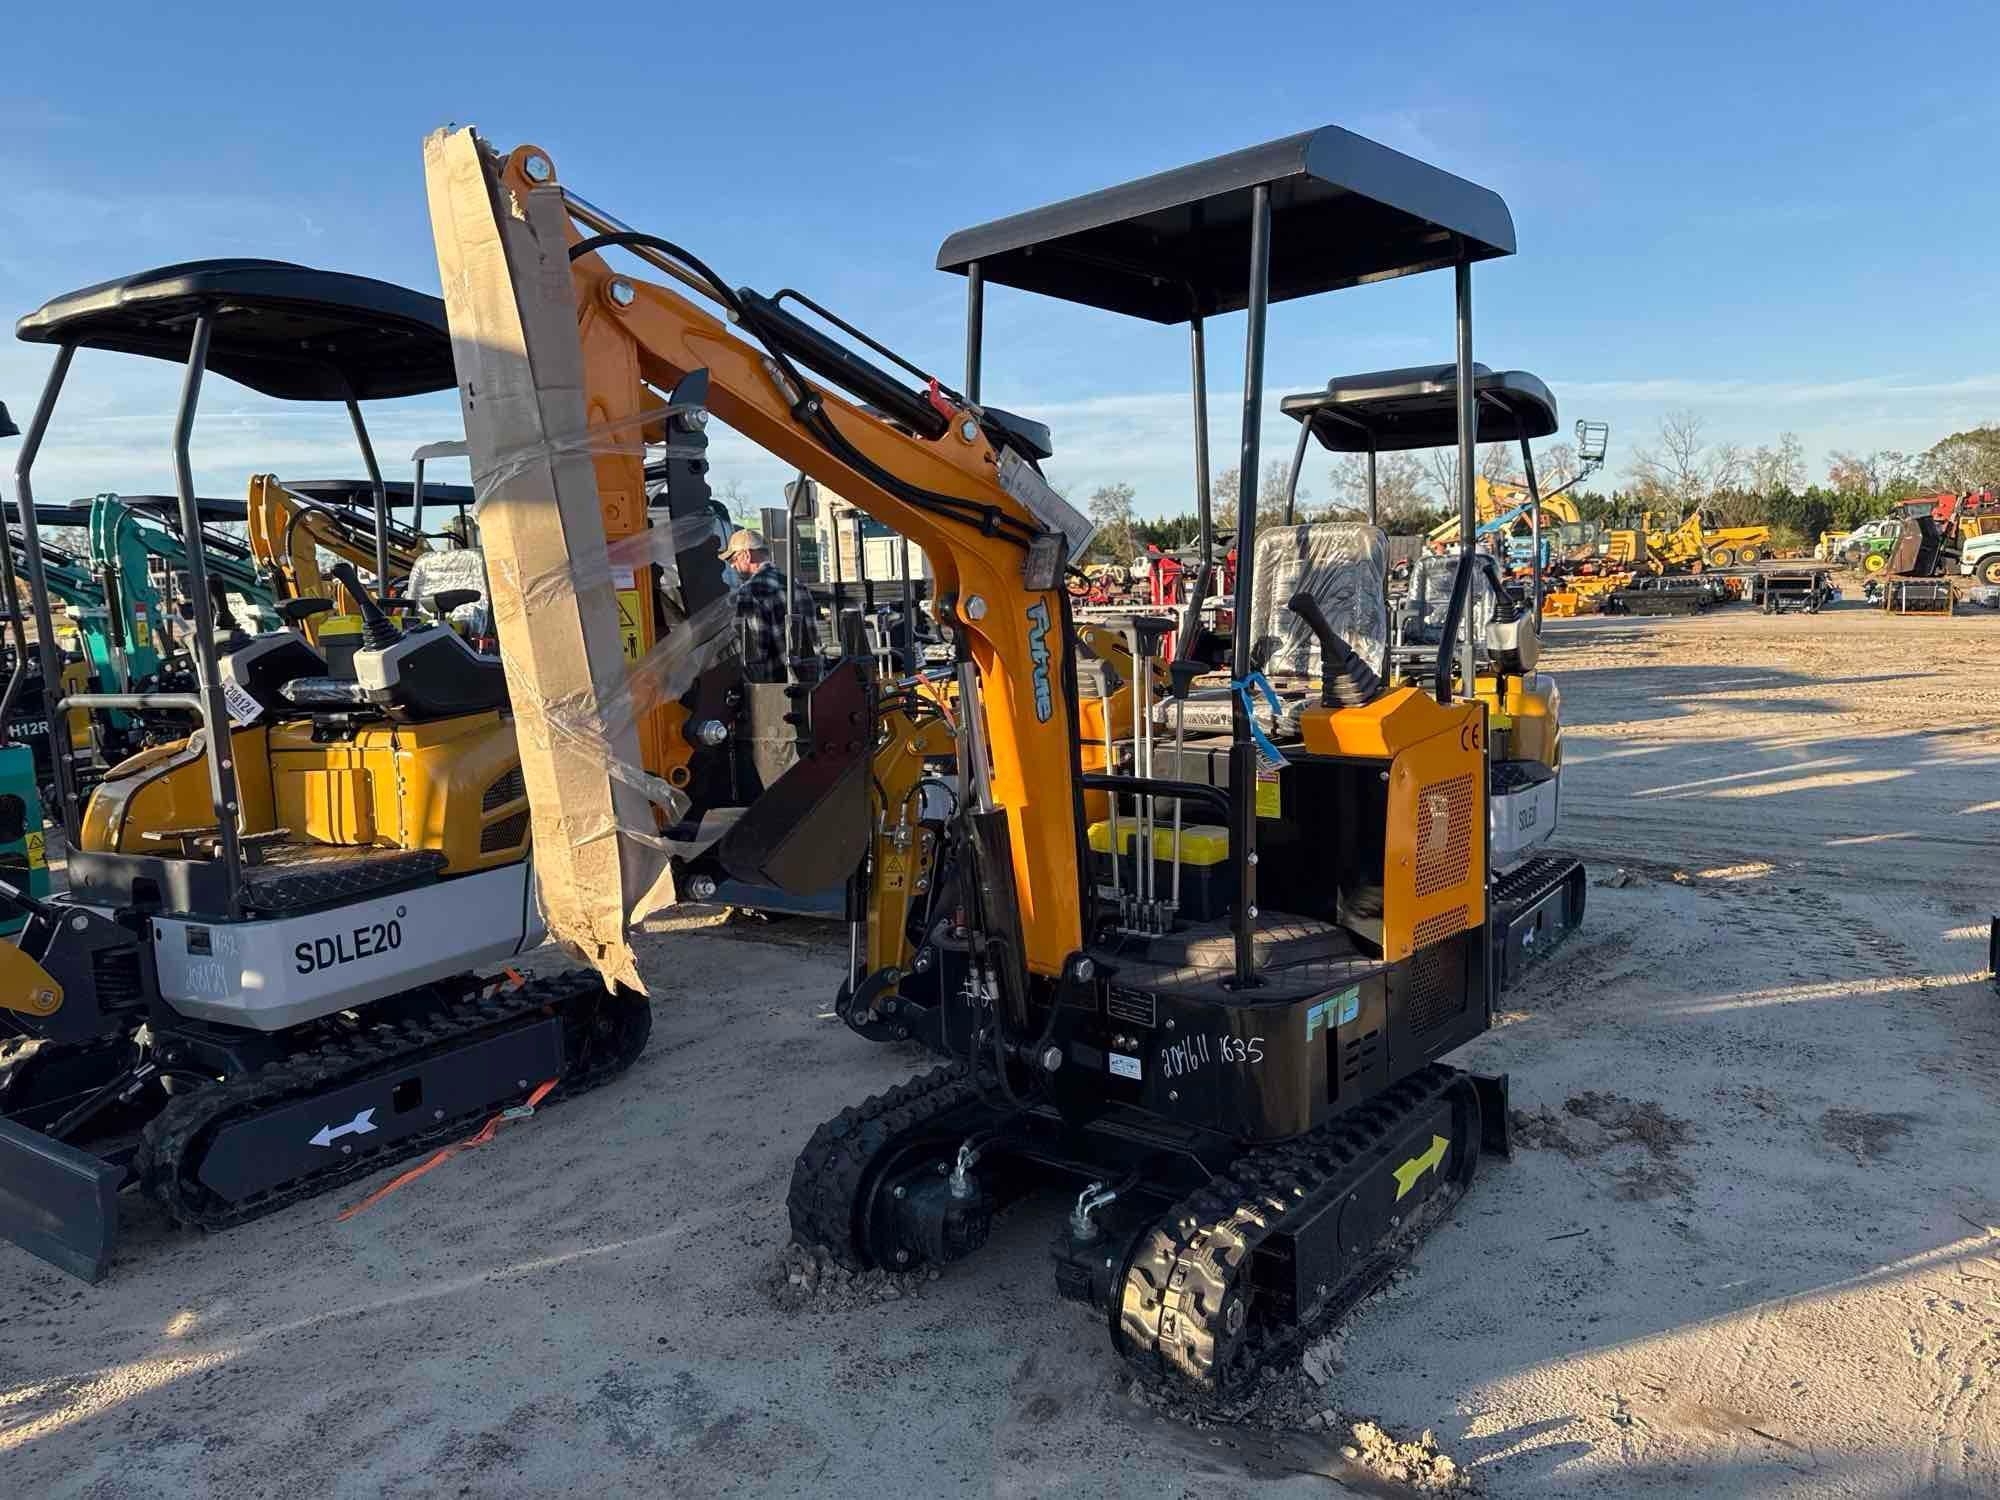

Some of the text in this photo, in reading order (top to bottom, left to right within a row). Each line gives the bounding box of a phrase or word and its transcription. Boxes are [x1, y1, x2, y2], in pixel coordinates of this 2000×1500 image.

[8, 721, 51, 738] H12R
[295, 919, 402, 975] SDLE20
[1161, 1033, 1210, 1079] 204611
[1219, 1034, 1265, 1065] 1635
